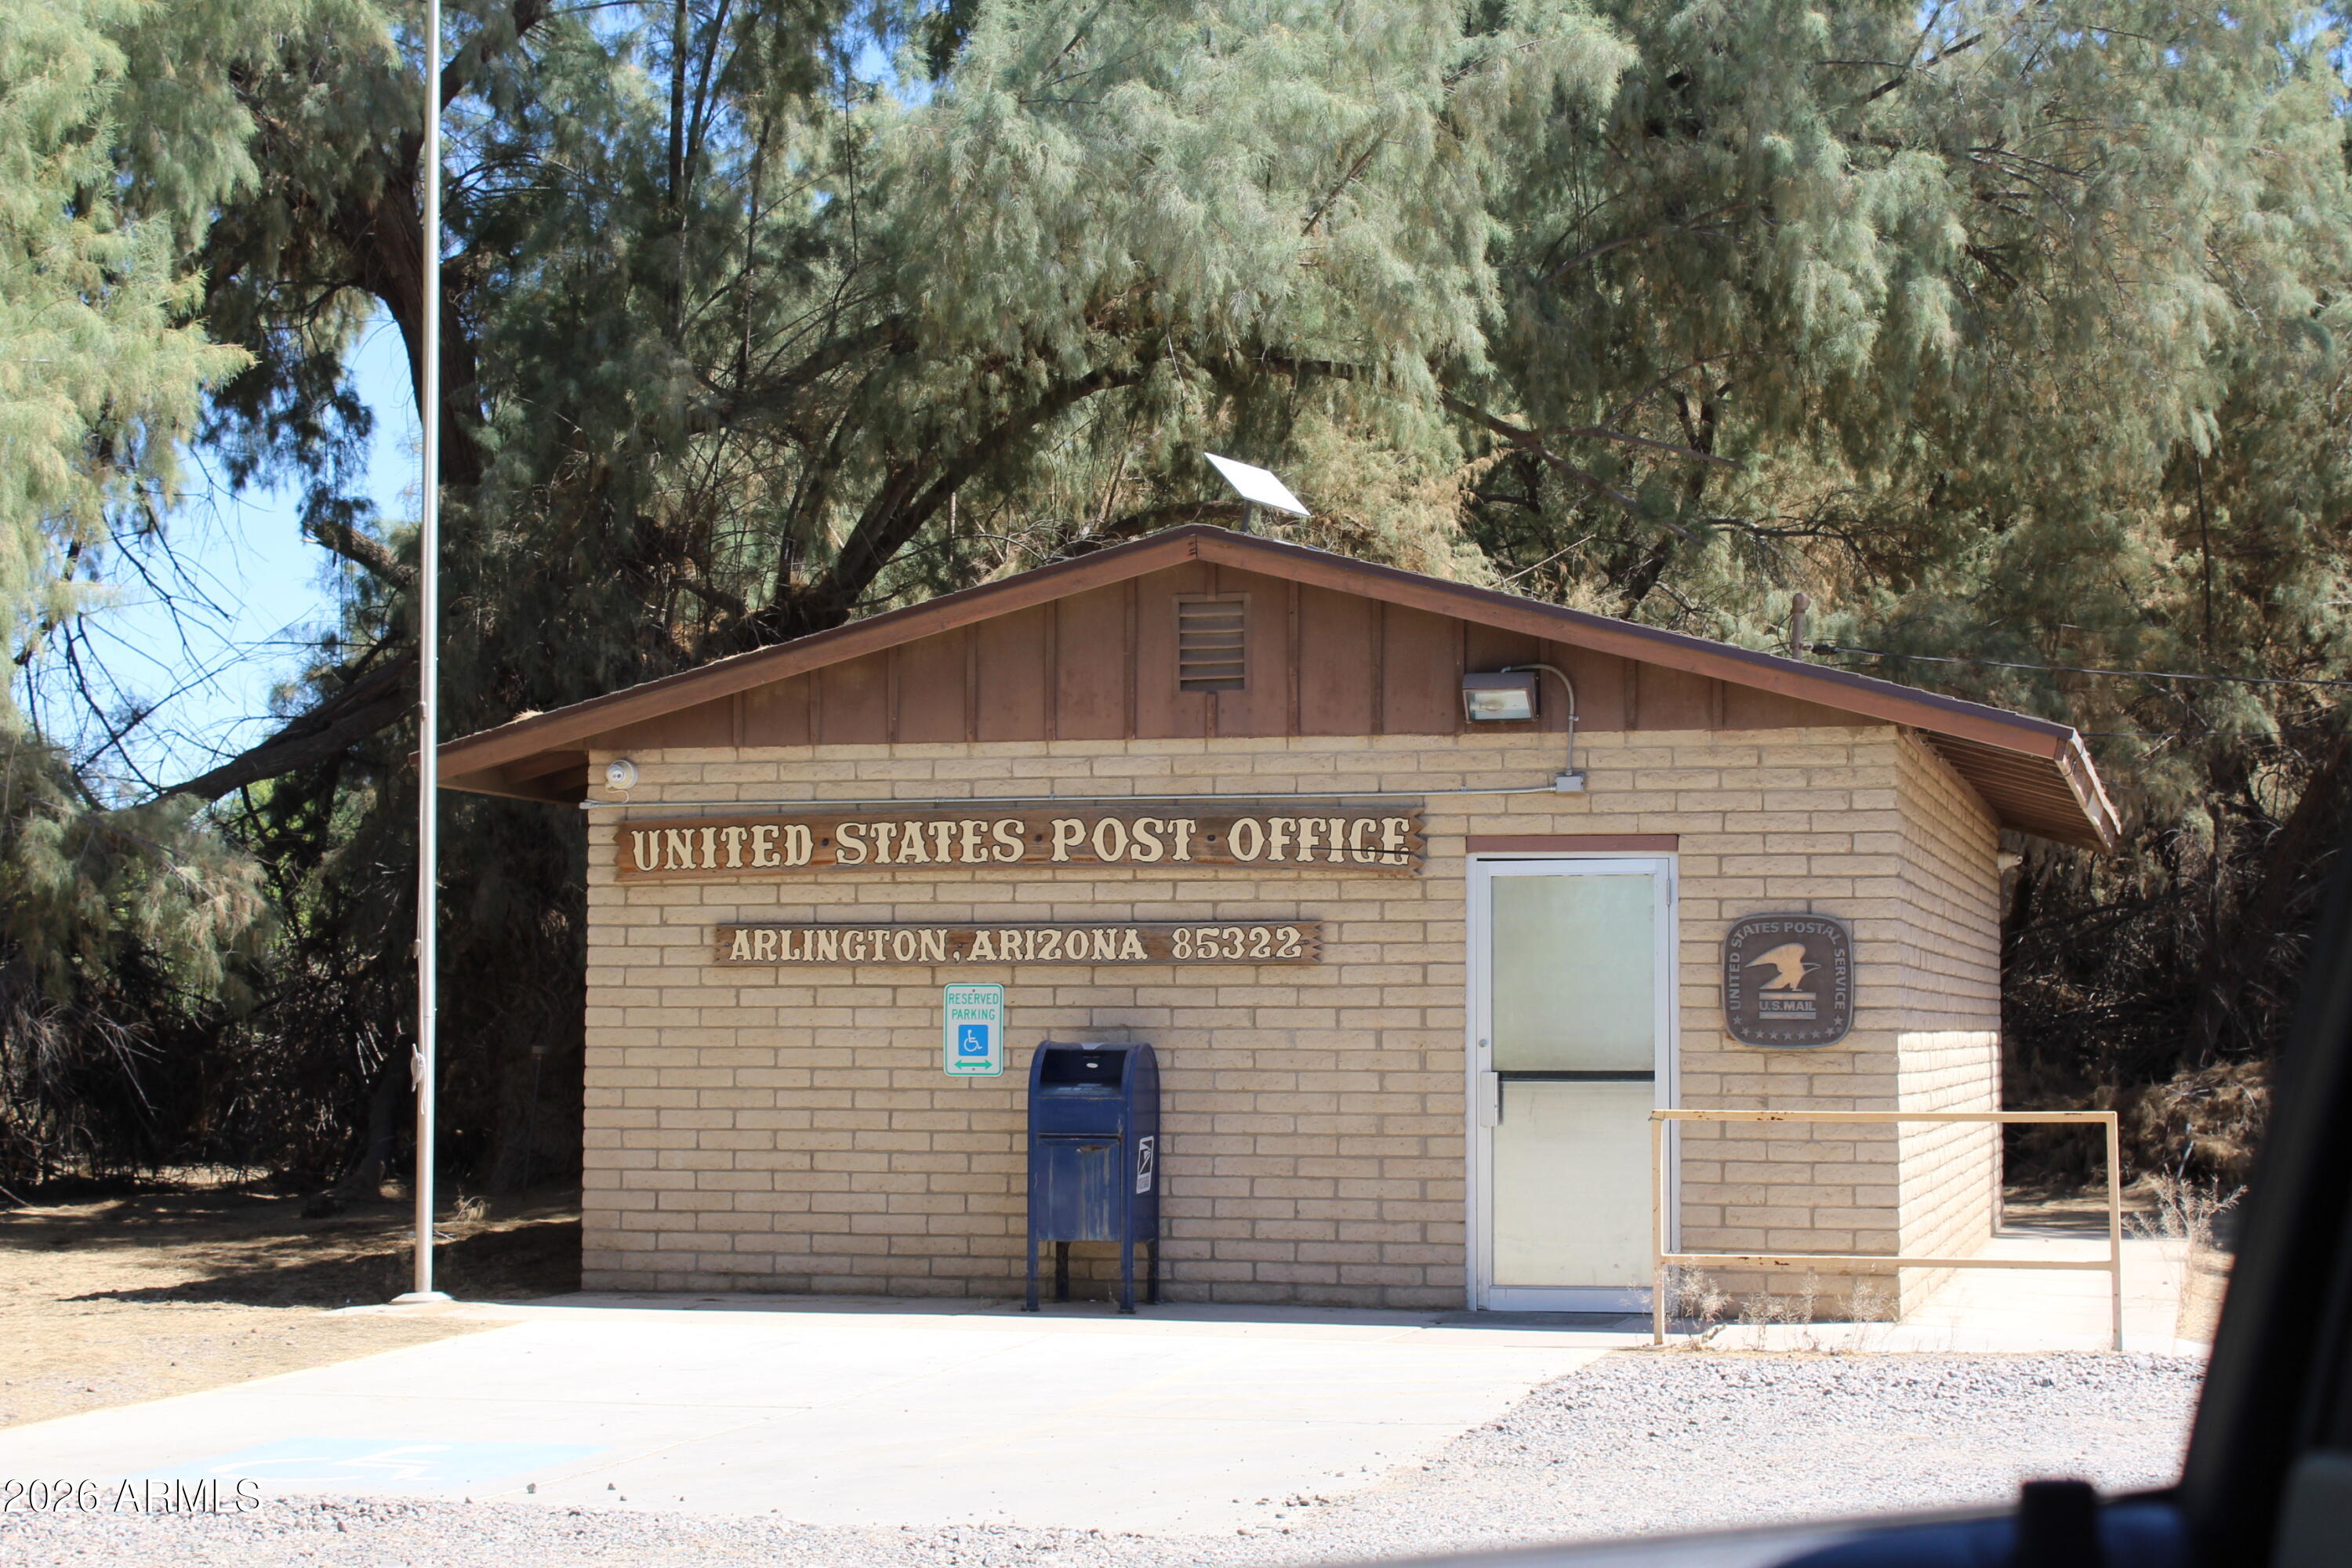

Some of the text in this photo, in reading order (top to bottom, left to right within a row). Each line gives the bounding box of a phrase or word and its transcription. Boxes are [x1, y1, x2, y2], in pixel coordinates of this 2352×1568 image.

[630, 816, 1410, 872] UNITED STATES POST OFFICE
[729, 927, 1305, 964] ARLINGTON, ARIZONA 85322
[1729, 922, 1846, 1010] UNITED STATES POSTAL SERVICE
[949, 993, 999, 1020] RESERVED PARKING
